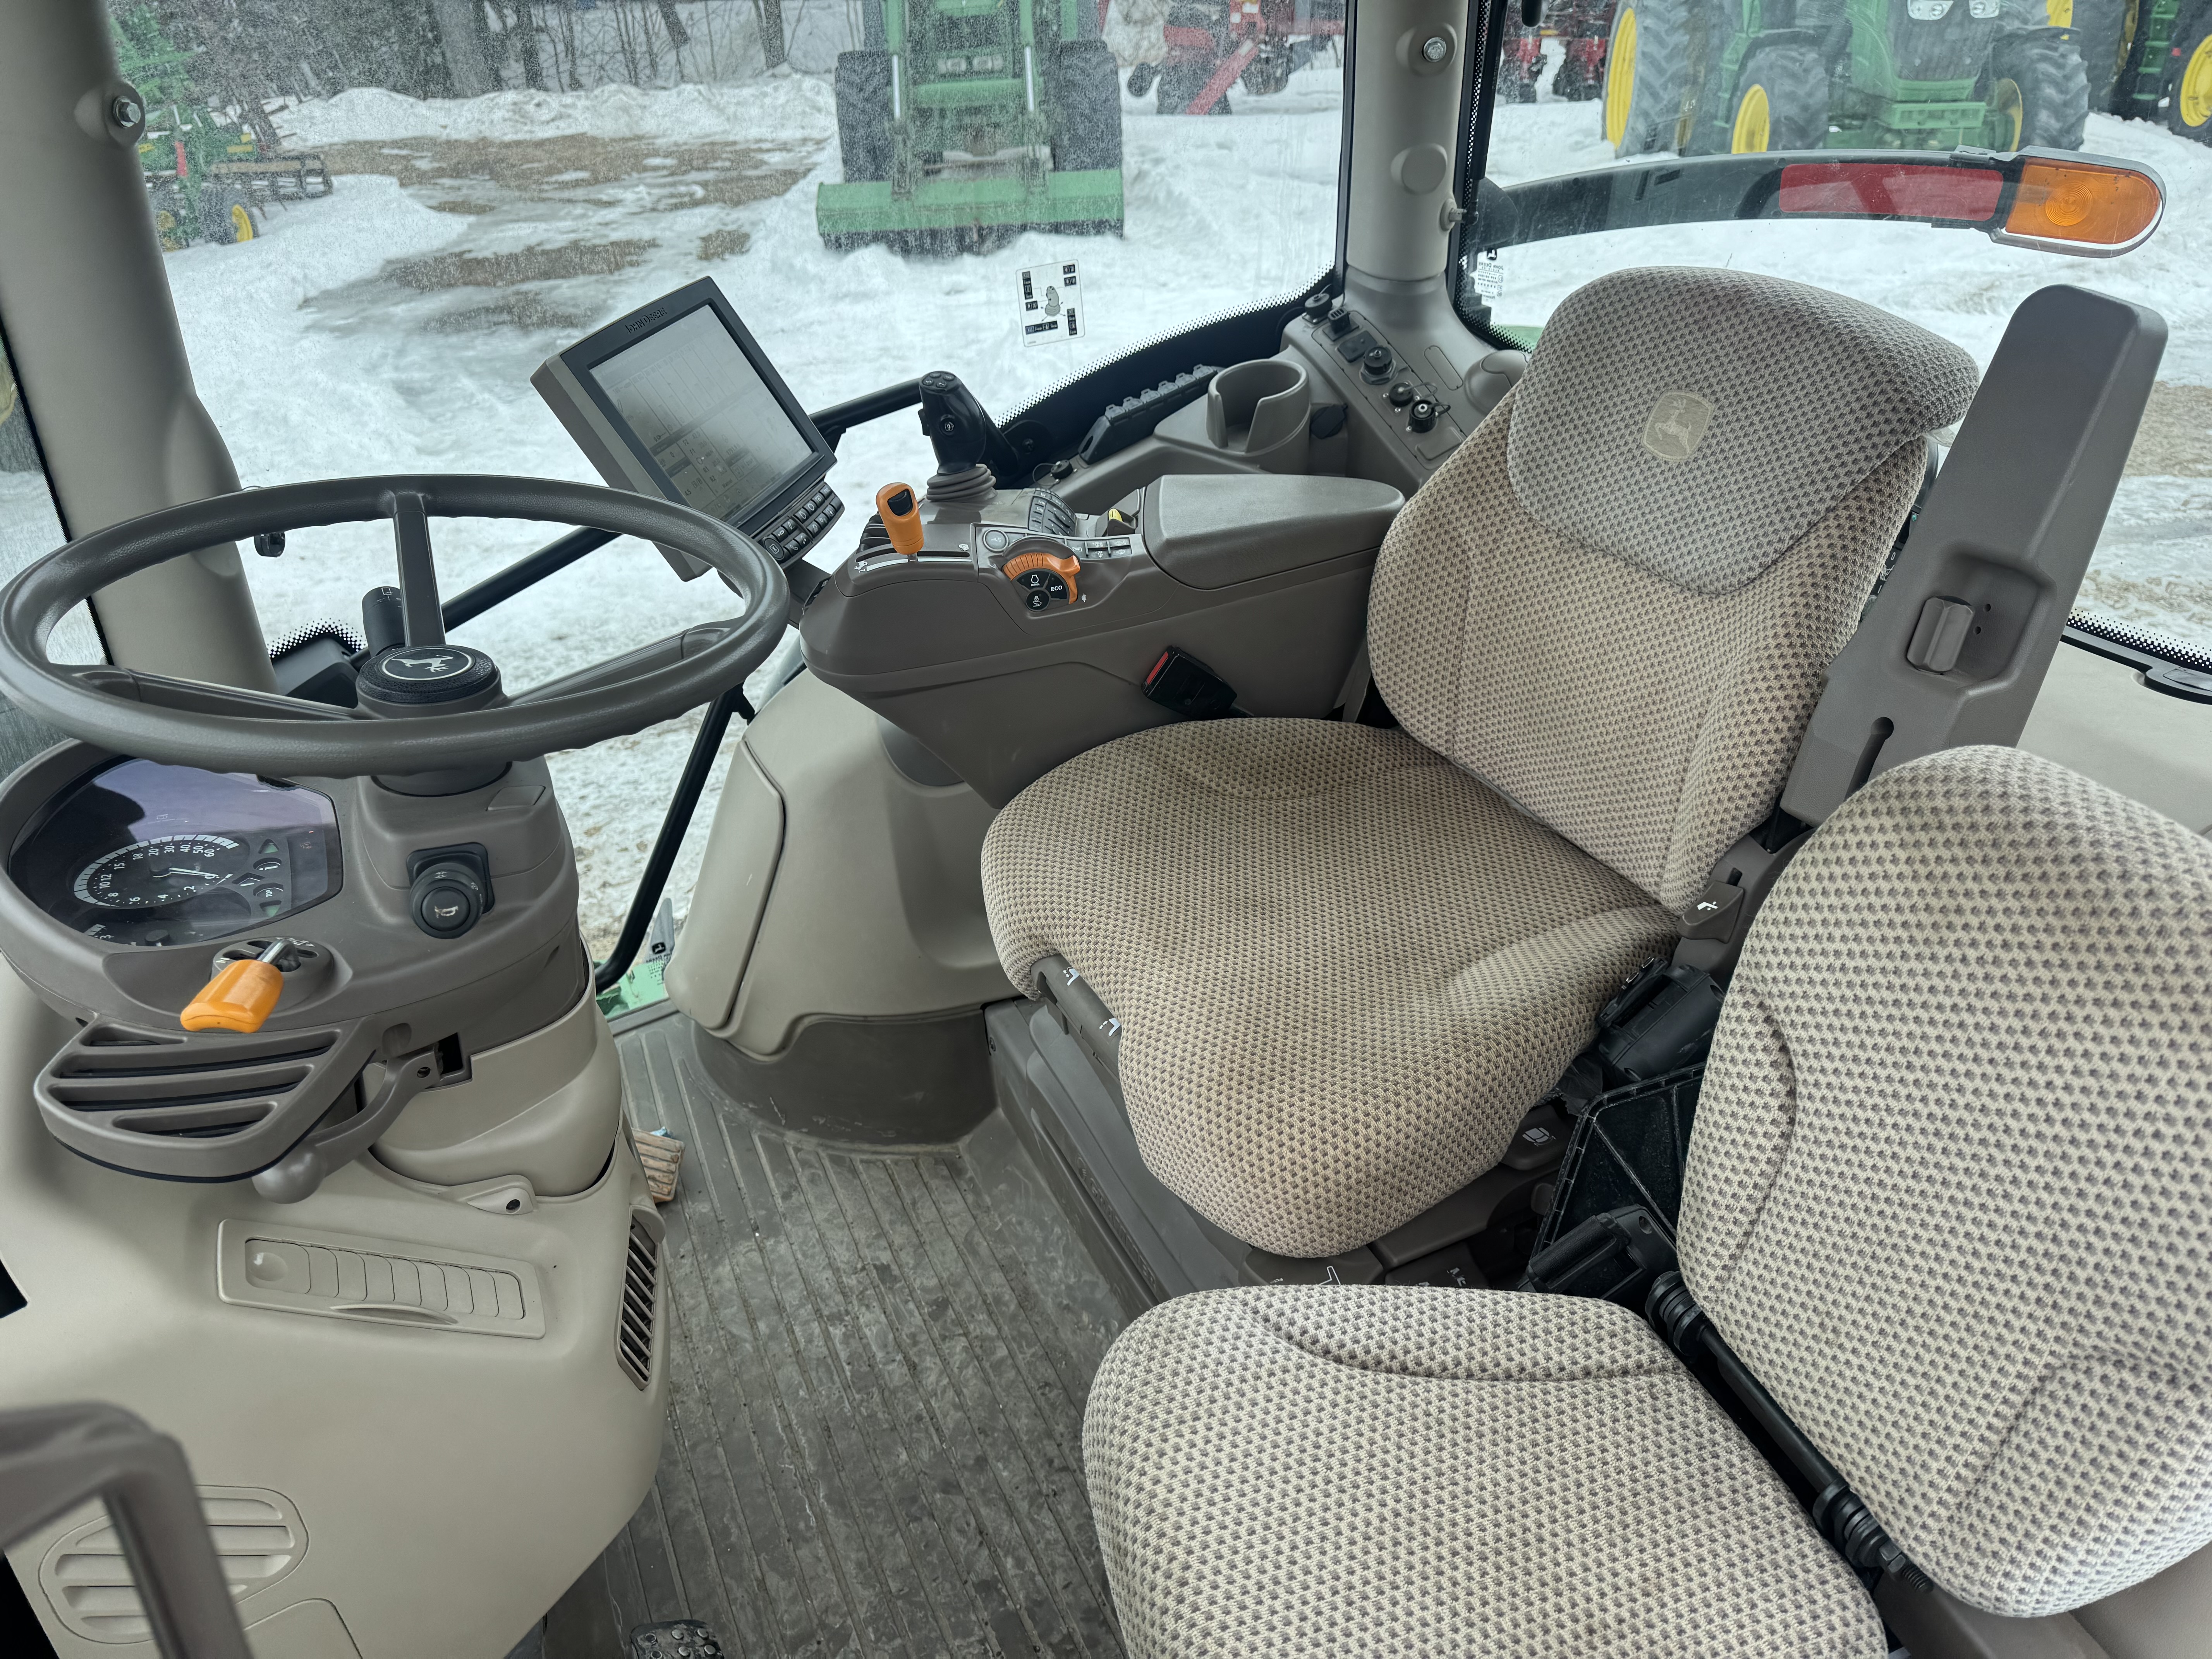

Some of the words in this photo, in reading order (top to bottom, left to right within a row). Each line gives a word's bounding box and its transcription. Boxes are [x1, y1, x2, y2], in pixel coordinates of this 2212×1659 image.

[625, 319, 645, 334] JOHN
[642, 307, 667, 323] DEERE
[180, 844, 191, 852] 40
[193, 845, 204, 854] 50
[204, 848, 215, 857] 60
